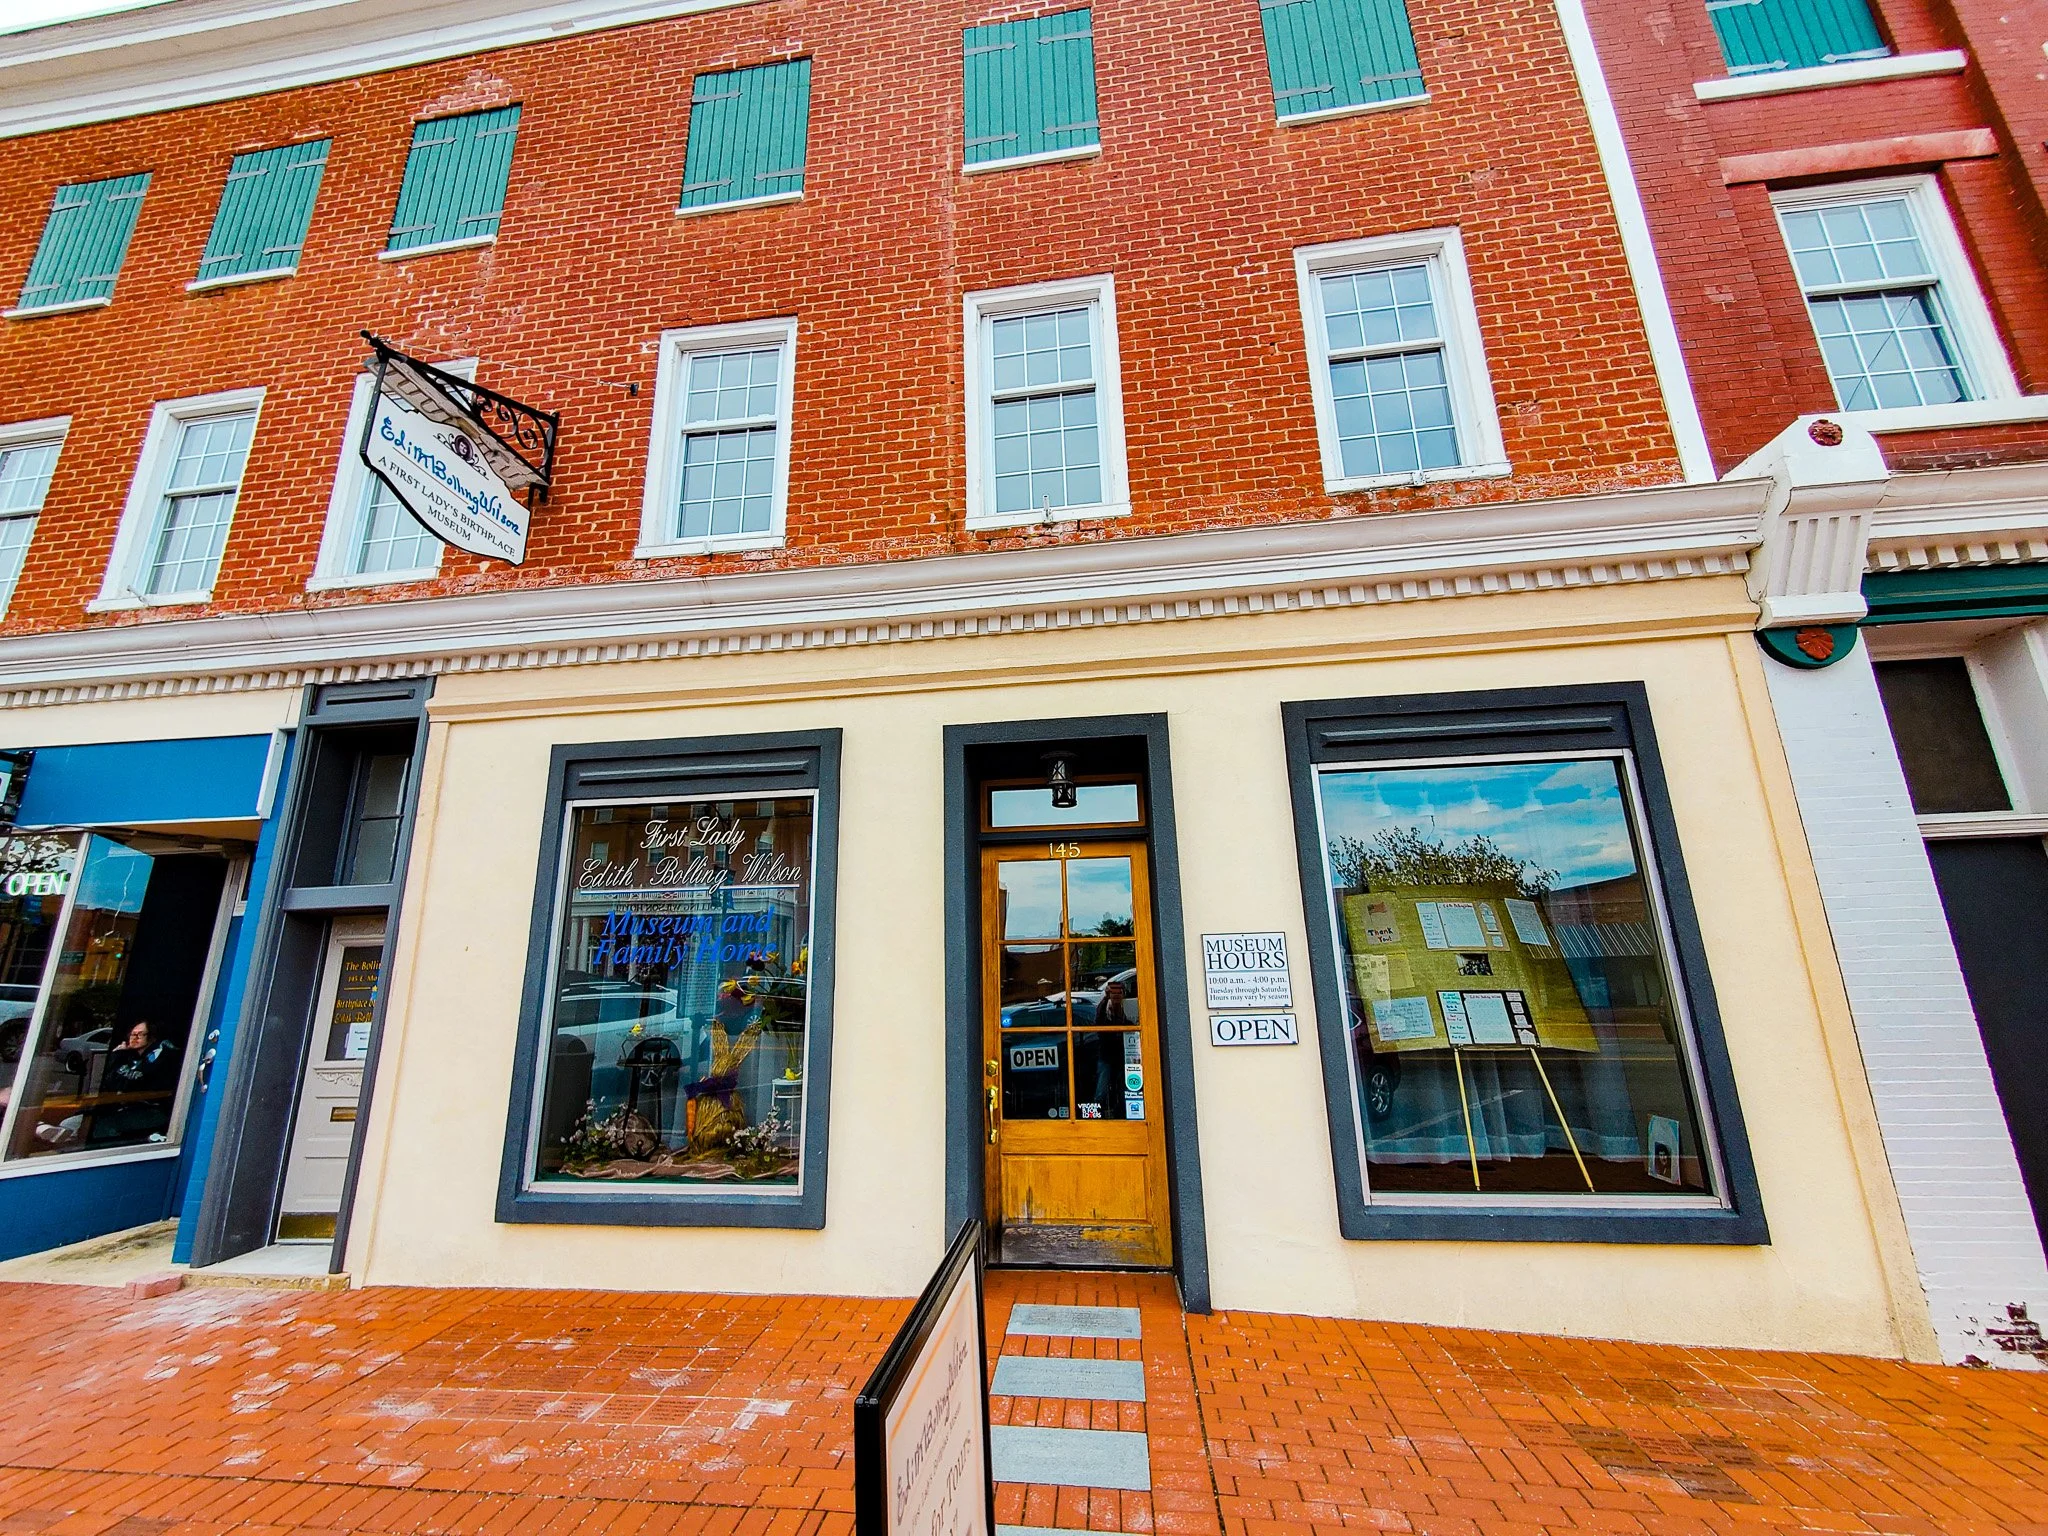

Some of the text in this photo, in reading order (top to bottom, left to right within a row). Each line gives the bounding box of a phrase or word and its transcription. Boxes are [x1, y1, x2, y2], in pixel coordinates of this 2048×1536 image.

[431, 454, 480, 516] Bolling
[479, 490, 521, 536] Wilson
[378, 455, 517, 558] A FIRST LADY'S BIRTHPLACE
[426, 505, 472, 541] MUSEUM
[639, 815, 747, 855] First Lady
[1049, 842, 1082, 858] 145
[577, 851, 803, 895] Edith Bolling Wilson
[6, 871, 67, 897] OPEN
[600, 903, 777, 937] Museum and
[1366, 927, 1394, 936] Thank
[592, 934, 779, 972] Family Home
[1206, 938, 1284, 953] MUSEUM
[346, 962, 360, 971] The
[1207, 951, 1285, 970] HOURS
[1208, 977, 1228, 985] 10:00
[1270, 976, 1288, 985] p.m.
[1209, 986, 1288, 995] Tuesday through Saturday
[1259, 993, 1267, 1002] by
[1268, 993, 1289, 1001] season
[1217, 1018, 1290, 1041] OPEN
[1013, 1049, 1056, 1067] OPEN
